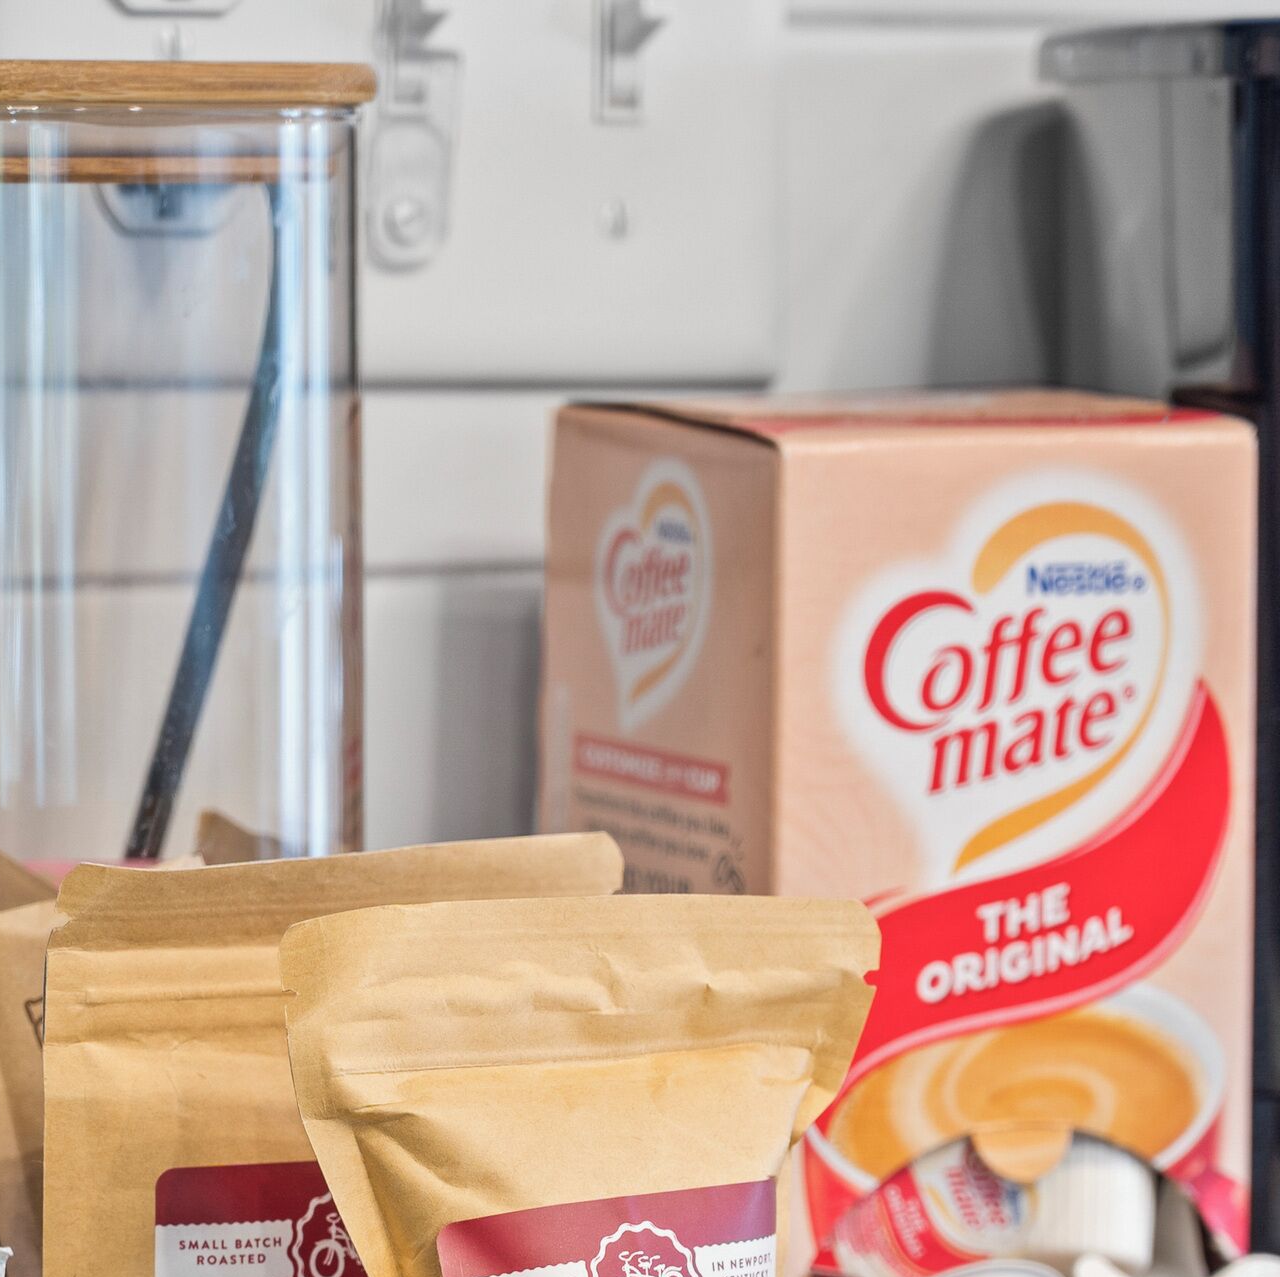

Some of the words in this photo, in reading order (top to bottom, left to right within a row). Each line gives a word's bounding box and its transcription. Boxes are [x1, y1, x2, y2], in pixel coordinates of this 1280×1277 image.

[603, 528, 691, 618] Coffee
[862, 588, 1133, 735] Coffee
[928, 691, 1116, 797] mate
[976, 882, 1070, 943] THE
[916, 906, 1134, 1004] ORIGINAL
[179, 1239, 227, 1251] SMALL
[235, 1237, 283, 1249] BATCH
[196, 1253, 267, 1266] ROASTED
[711, 1261, 725, 1272] IN
[730, 1252, 773, 1270] NEWPORT,
